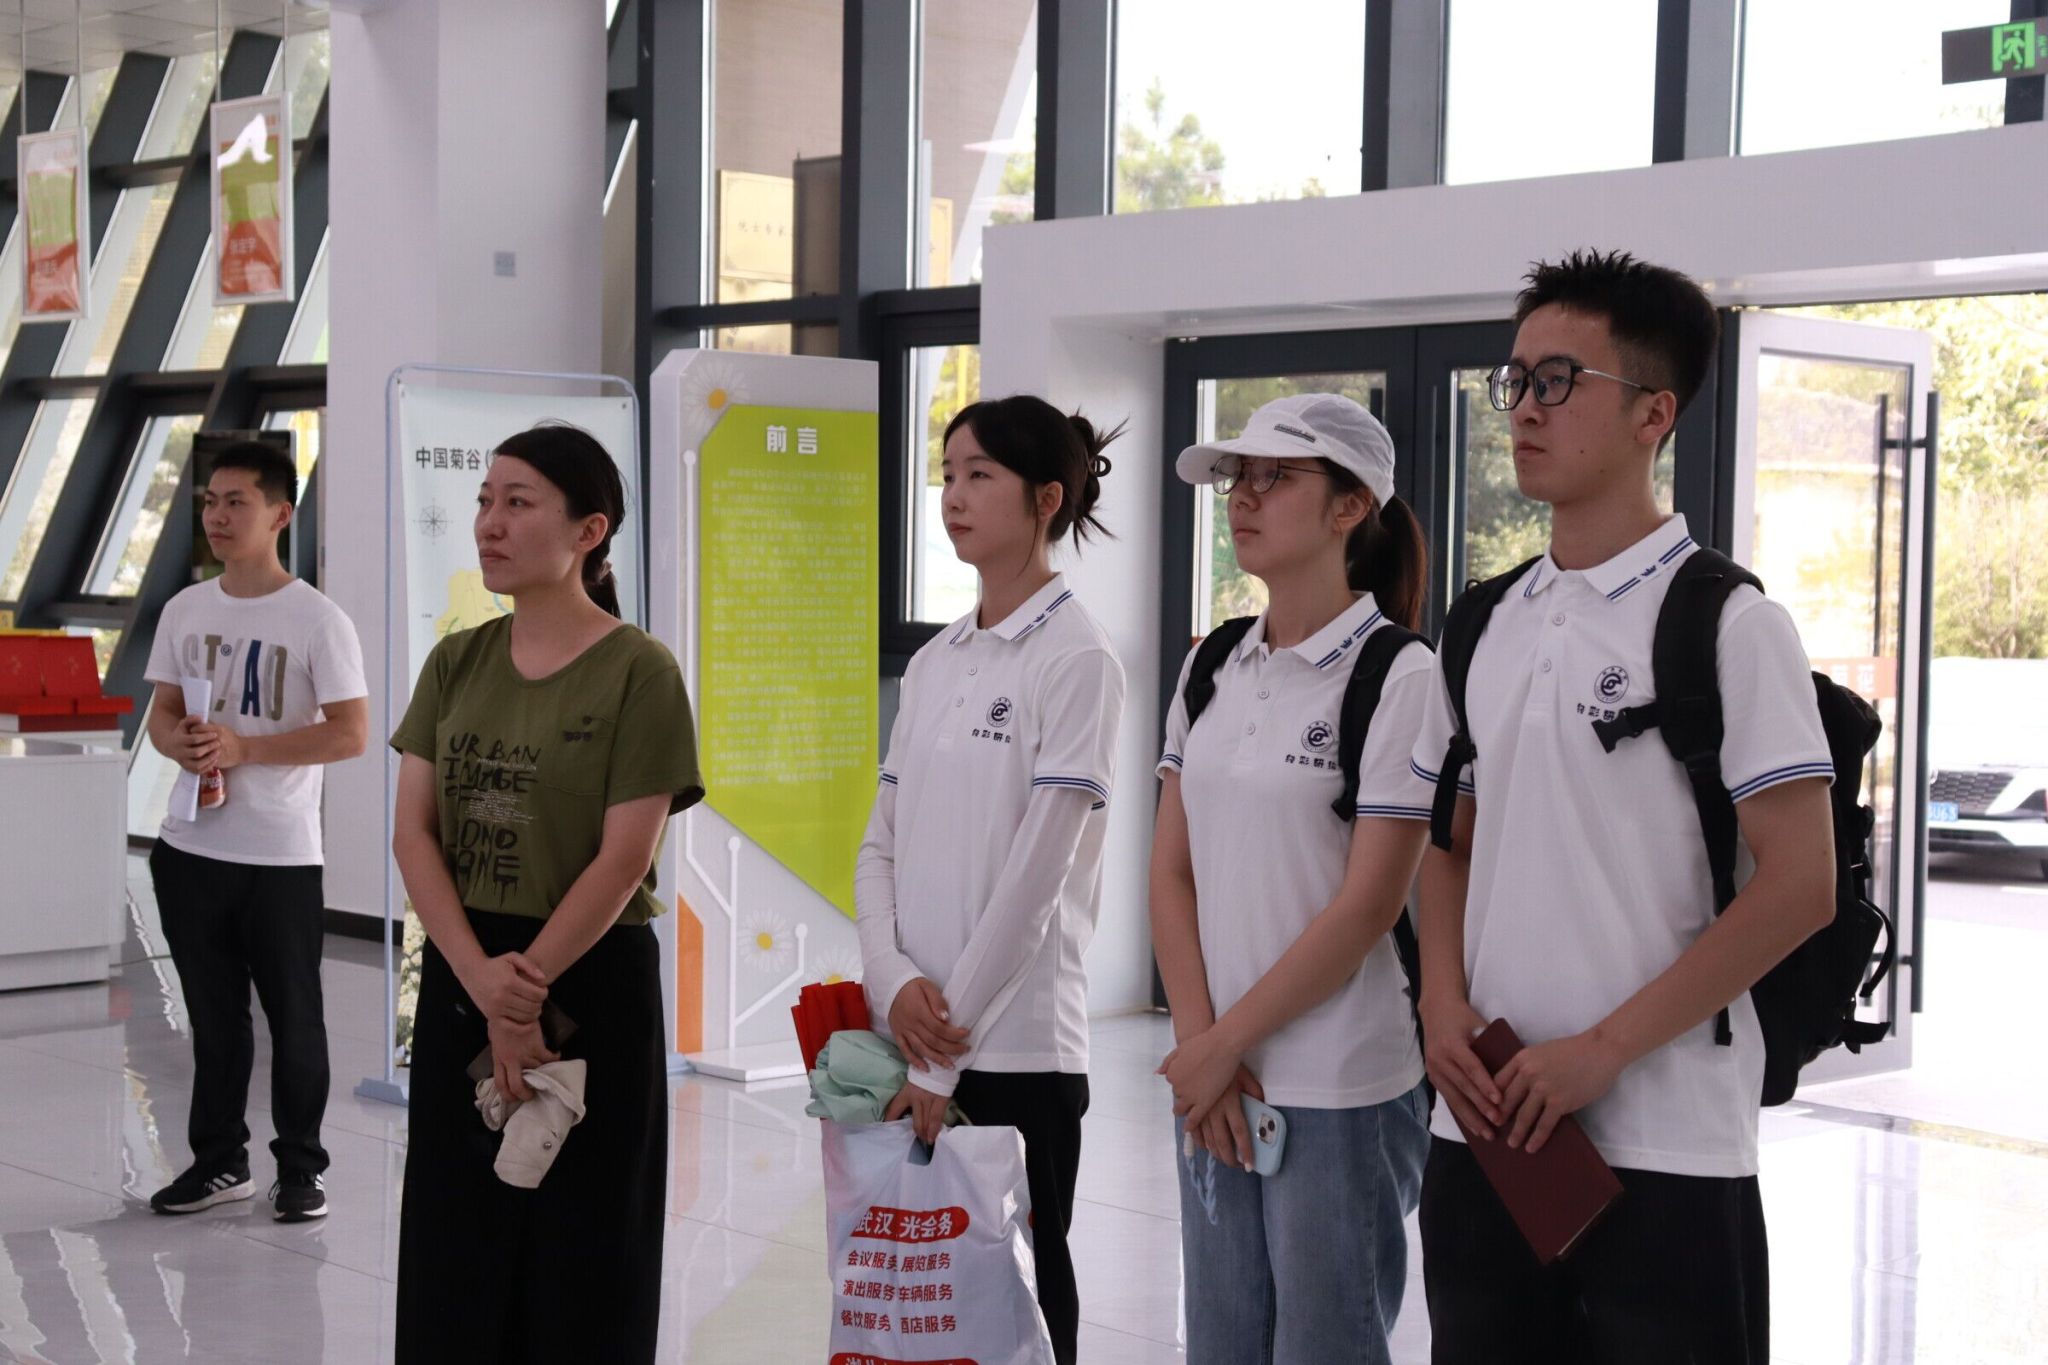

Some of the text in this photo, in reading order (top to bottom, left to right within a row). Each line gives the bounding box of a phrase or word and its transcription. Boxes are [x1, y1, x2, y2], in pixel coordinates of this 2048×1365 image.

[767, 425, 817, 454] 前言
[416, 446, 499, 471] 中国菊谷(
[450, 732, 541, 764] URBAN
[444, 757, 539, 794] IMAGE
[847, 1249, 952, 1273] 会议服务 展览服务
[843, 1279, 954, 1303] 演出服务 车辆服务
[840, 1309, 892, 1332] 餐饮服务
